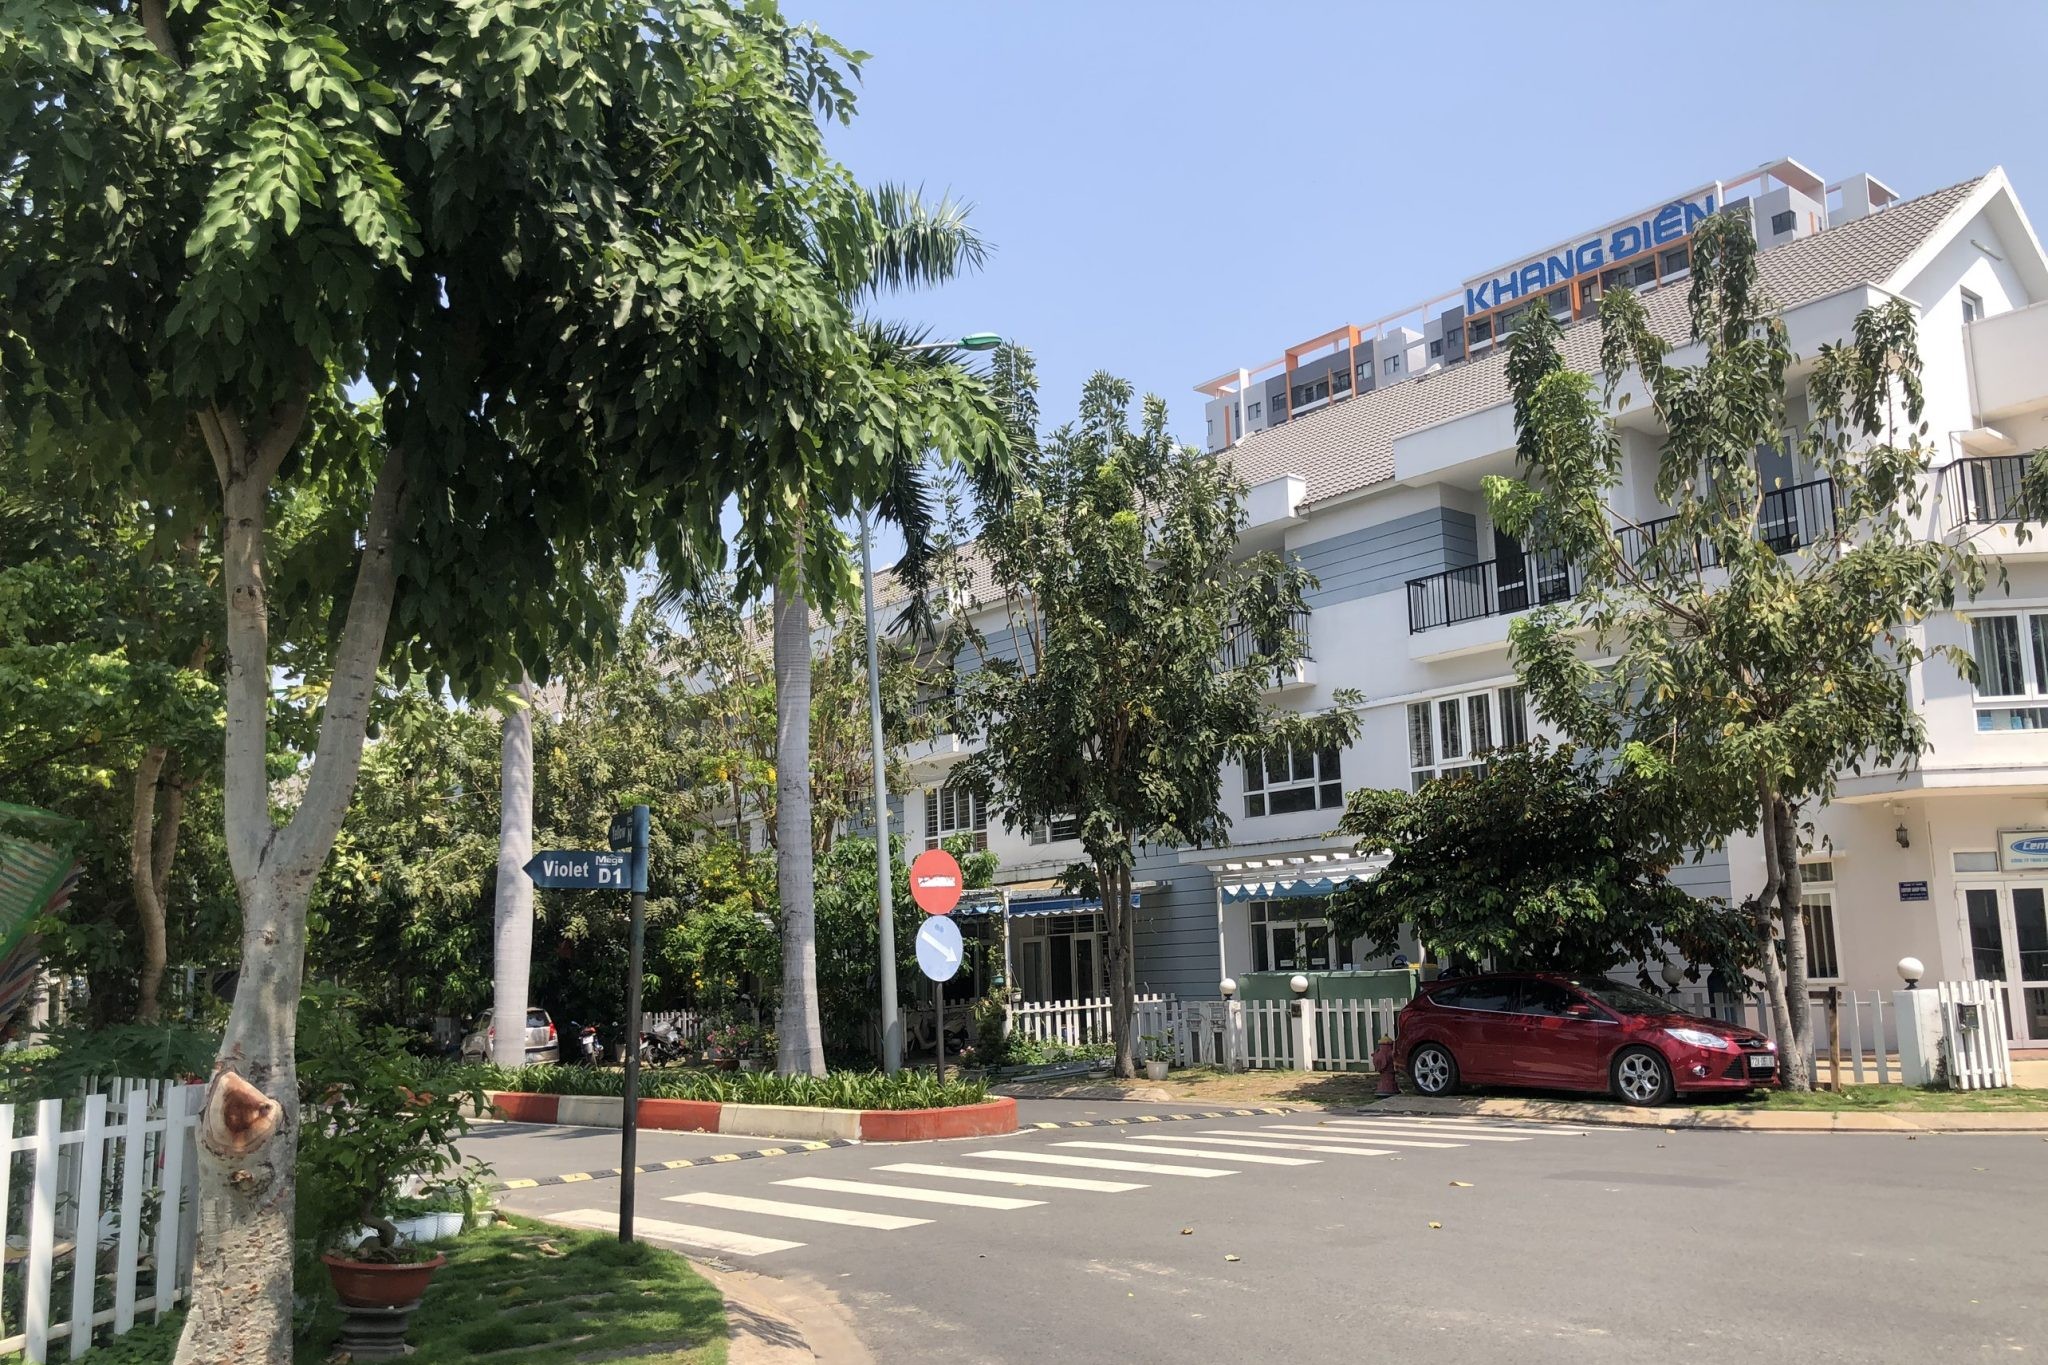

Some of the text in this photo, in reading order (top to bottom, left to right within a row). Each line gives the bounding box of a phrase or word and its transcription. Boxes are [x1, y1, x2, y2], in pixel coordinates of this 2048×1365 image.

[1466, 238, 1605, 316] KHANG
[543, 860, 589, 877] Violet
[596, 855, 624, 867] Mega
[598, 868, 622, 884] D1
